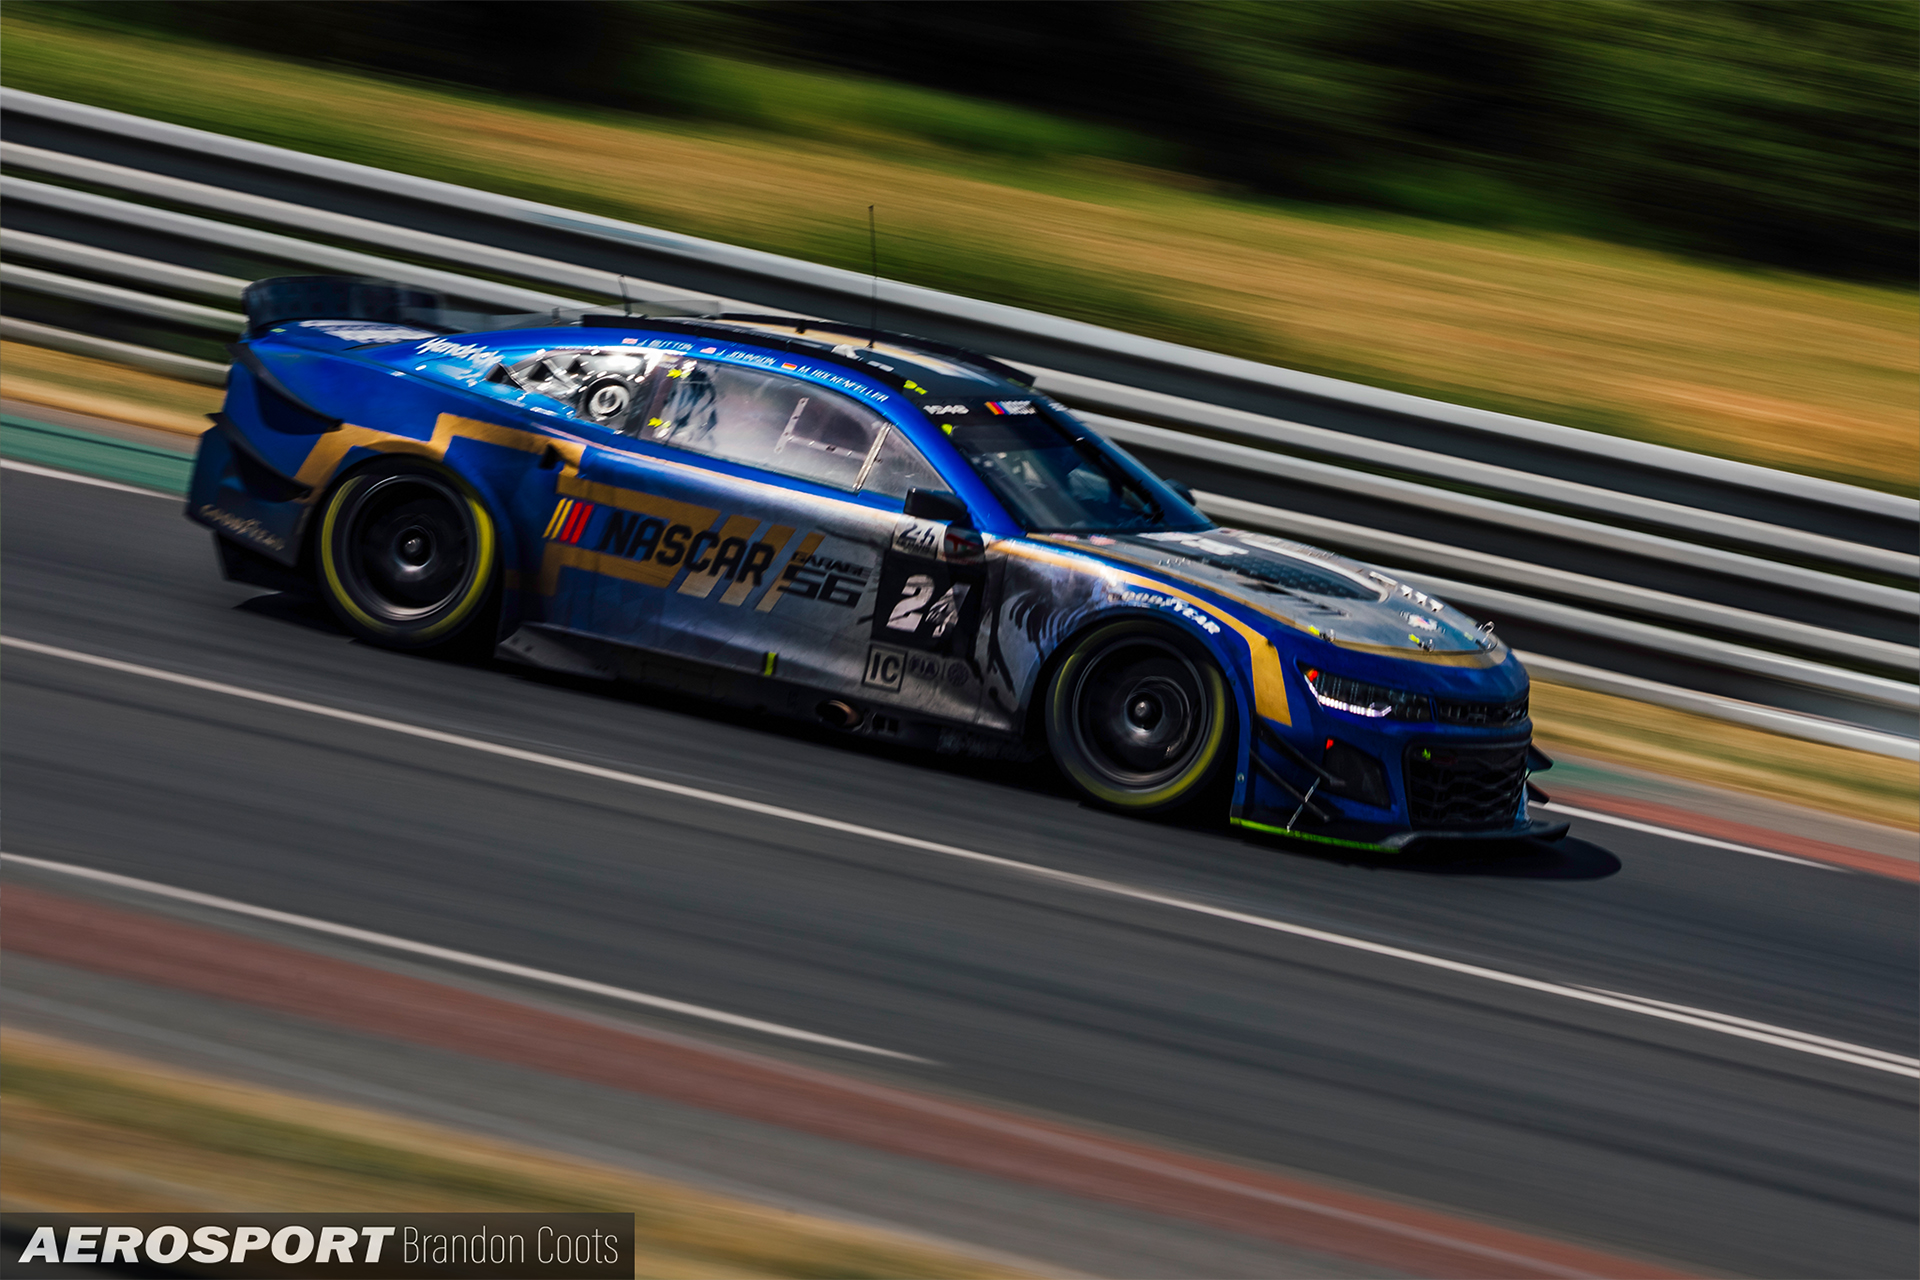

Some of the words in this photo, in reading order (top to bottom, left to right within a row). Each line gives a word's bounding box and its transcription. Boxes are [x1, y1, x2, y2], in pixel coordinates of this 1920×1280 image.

[598, 511, 776, 587] NASCAR
[776, 564, 868, 609] 56
[885, 574, 972, 638] 24
[870, 652, 900, 684] IC
